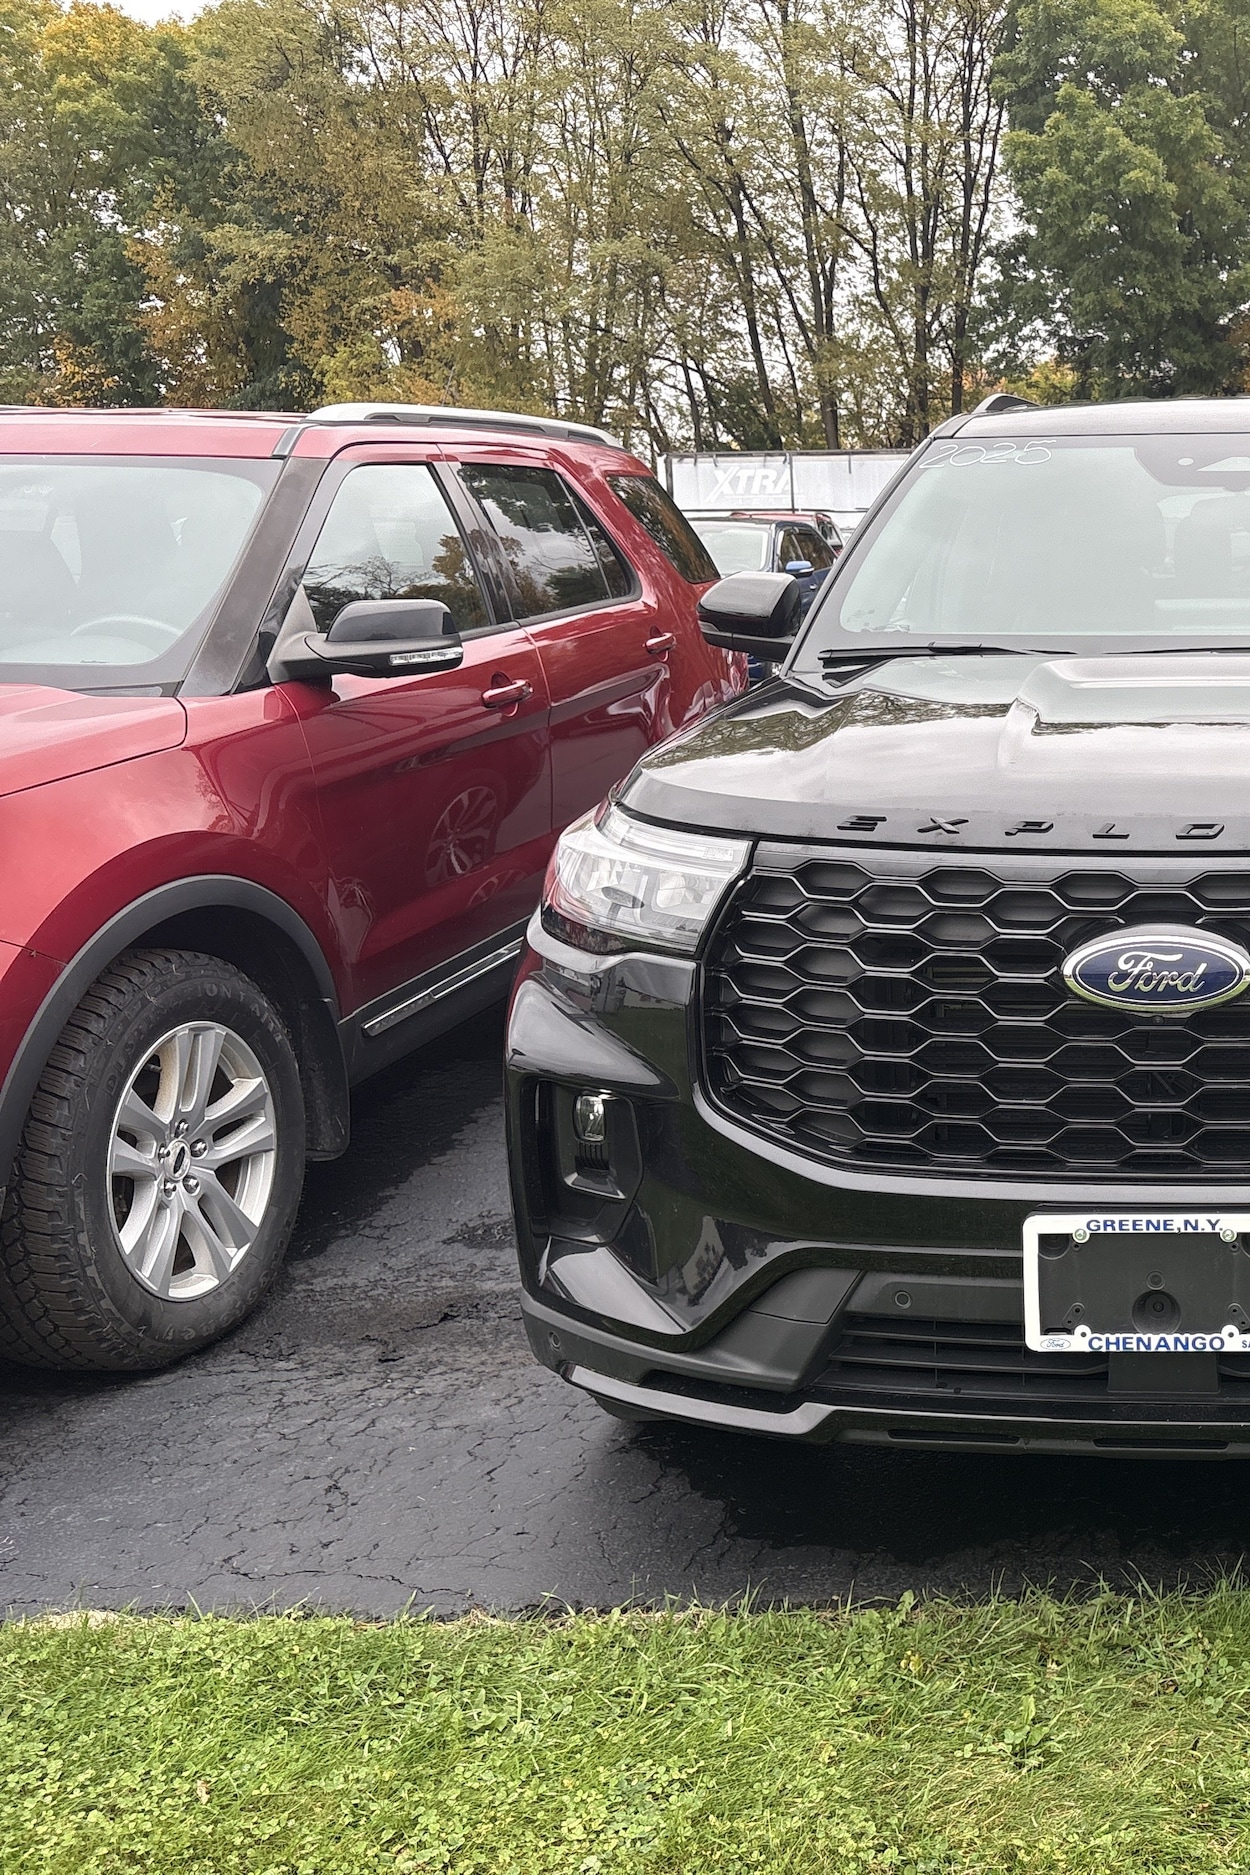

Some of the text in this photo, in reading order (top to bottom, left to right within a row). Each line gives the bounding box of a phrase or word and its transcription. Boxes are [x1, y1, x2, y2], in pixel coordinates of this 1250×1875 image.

[919, 440, 1057, 469] 2025
[705, 466, 798, 502] XTRA
[1108, 951, 1206, 992] Ford
[1045, 1338, 1066, 1349] Ford
[1088, 1336, 1225, 1352] CHENANGO
